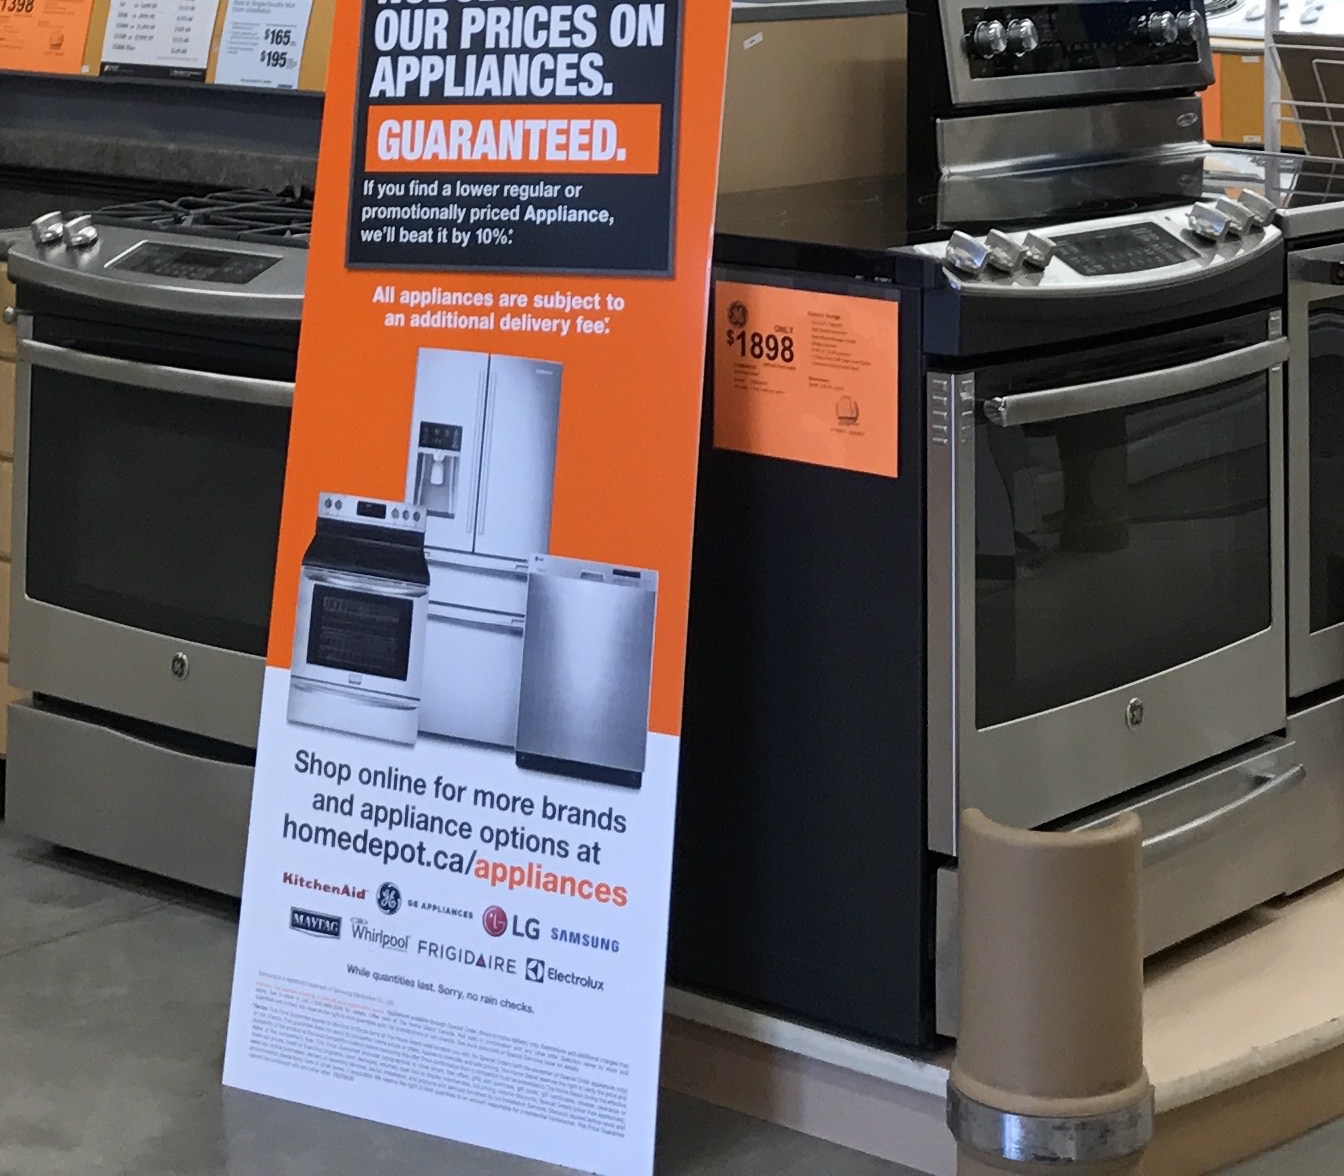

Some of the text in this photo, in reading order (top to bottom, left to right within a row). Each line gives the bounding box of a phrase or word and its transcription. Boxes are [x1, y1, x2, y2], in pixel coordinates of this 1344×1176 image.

[375, 3, 665, 51] OUR PRICES ON
[369, 53, 614, 99] APPLIANCES.
[377, 119, 627, 162] GUARANTEED.
[363, 179, 583, 201] If you find a lower regular or
[361, 203, 615, 226] promotionally priced Appliance,
[360, 226, 472, 247] we'll beat it by
[726, 328, 795, 363] $1898
[294, 749, 628, 834] Shop online for more brands
[312, 790, 602, 865] and appliance options at
[282, 871, 368, 900] KitchenAid
[512, 914, 621, 954] LG SAMSUNG
[350, 925, 605, 992] Whirlpool FRIGIDAIRE Electrolux
